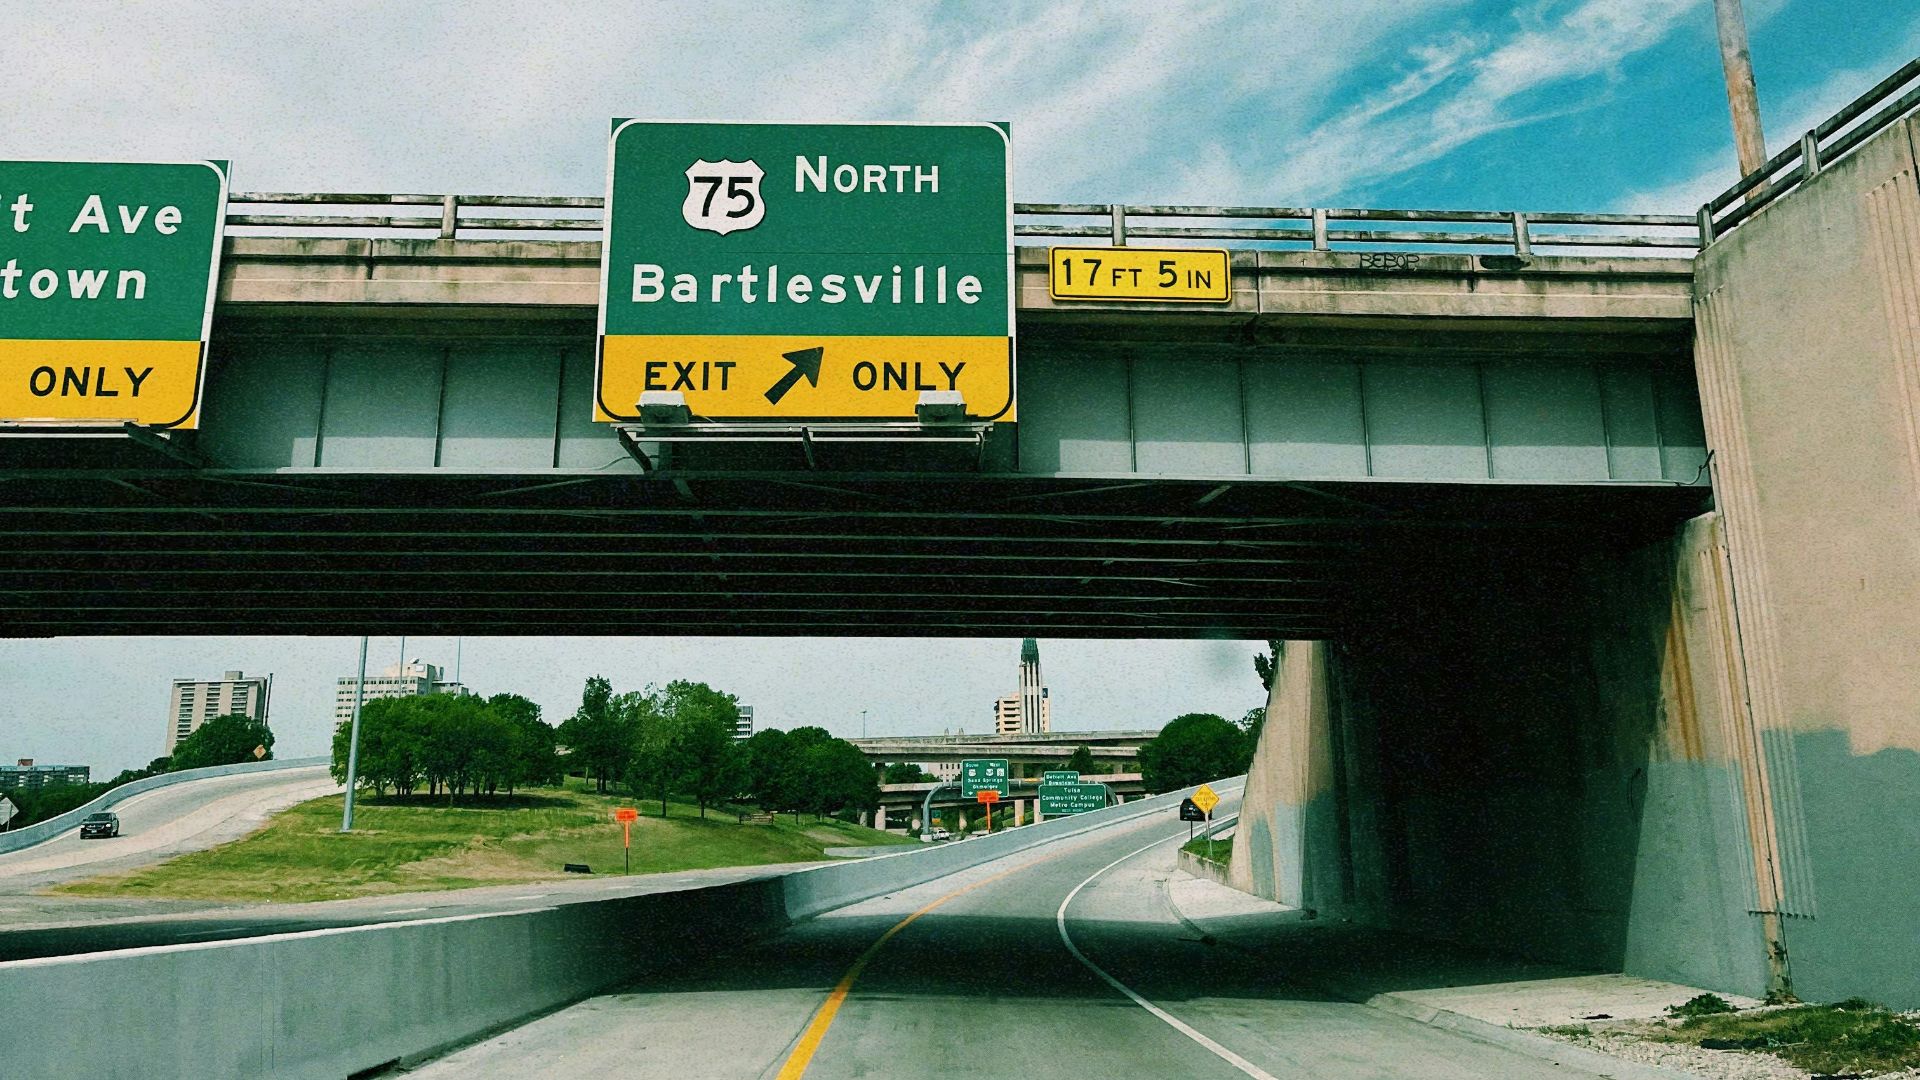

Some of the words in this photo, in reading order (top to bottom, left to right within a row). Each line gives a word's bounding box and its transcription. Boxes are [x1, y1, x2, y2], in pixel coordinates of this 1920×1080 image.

[69, 194, 183, 235] Ave
[693, 176, 755, 219] 75
[632, 263, 983, 305] Bartlesville
[1062, 258, 1102, 287] 17
[1112, 268, 1142, 287] FT
[1159, 260, 1178, 288] 5
[1187, 270, 1212, 289] IN
[29, 366, 154, 397] ONLY
[645, 361, 737, 392] EXIT
[852, 361, 967, 392] ONLY
